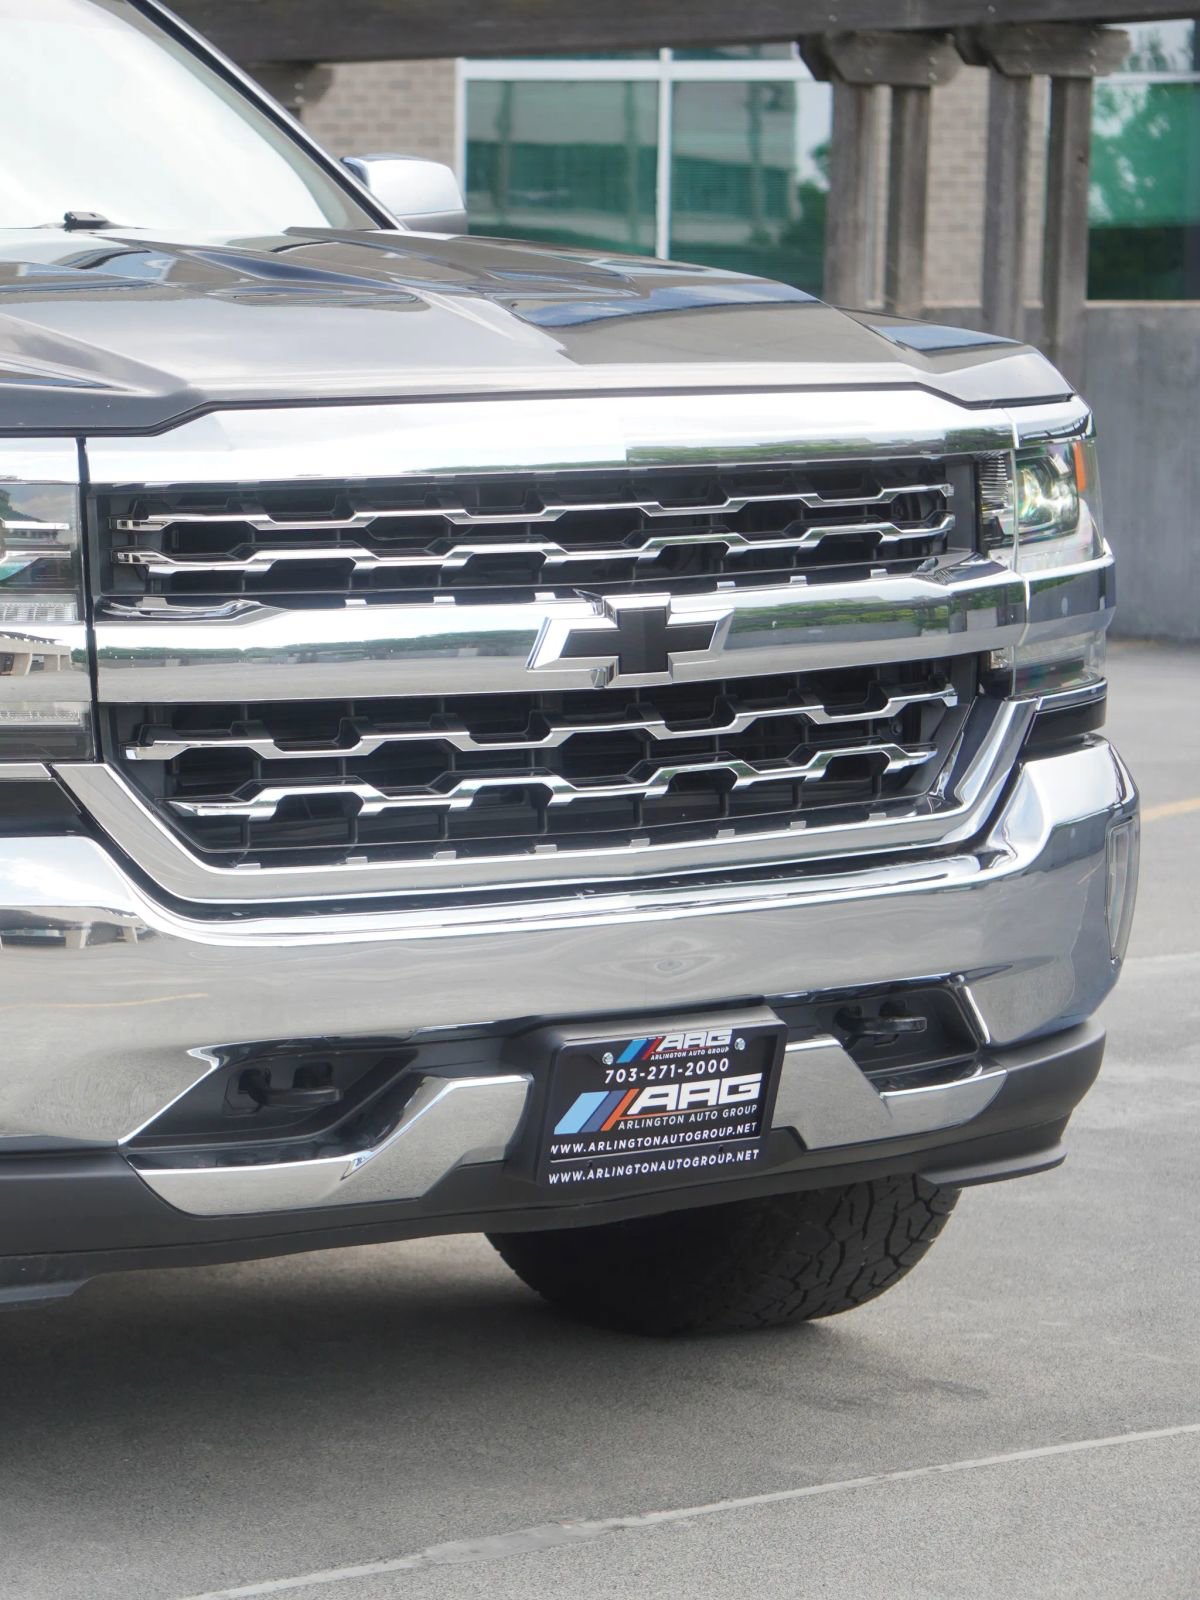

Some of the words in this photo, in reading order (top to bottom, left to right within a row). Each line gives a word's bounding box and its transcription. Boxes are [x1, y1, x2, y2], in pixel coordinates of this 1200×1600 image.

[650, 1050, 687, 1060] ARLINGTON
[688, 1049, 706, 1057] AUTO
[707, 1046, 730, 1055] GROUP
[656, 1029, 733, 1052] AAG
[604, 1057, 729, 1084] 703-271-2000
[626, 1072, 763, 1115] AAG
[618, 1115, 684, 1131] ARLINGTON
[689, 1110, 718, 1123] AUTO
[722, 1104, 758, 1119] GROUP
[550, 1121, 758, 1155] WWW.ARLINGTONAUTOGROUP.NET
[548, 1149, 760, 1184] WWW.ARLINGTONAUTOGROUP.NET
